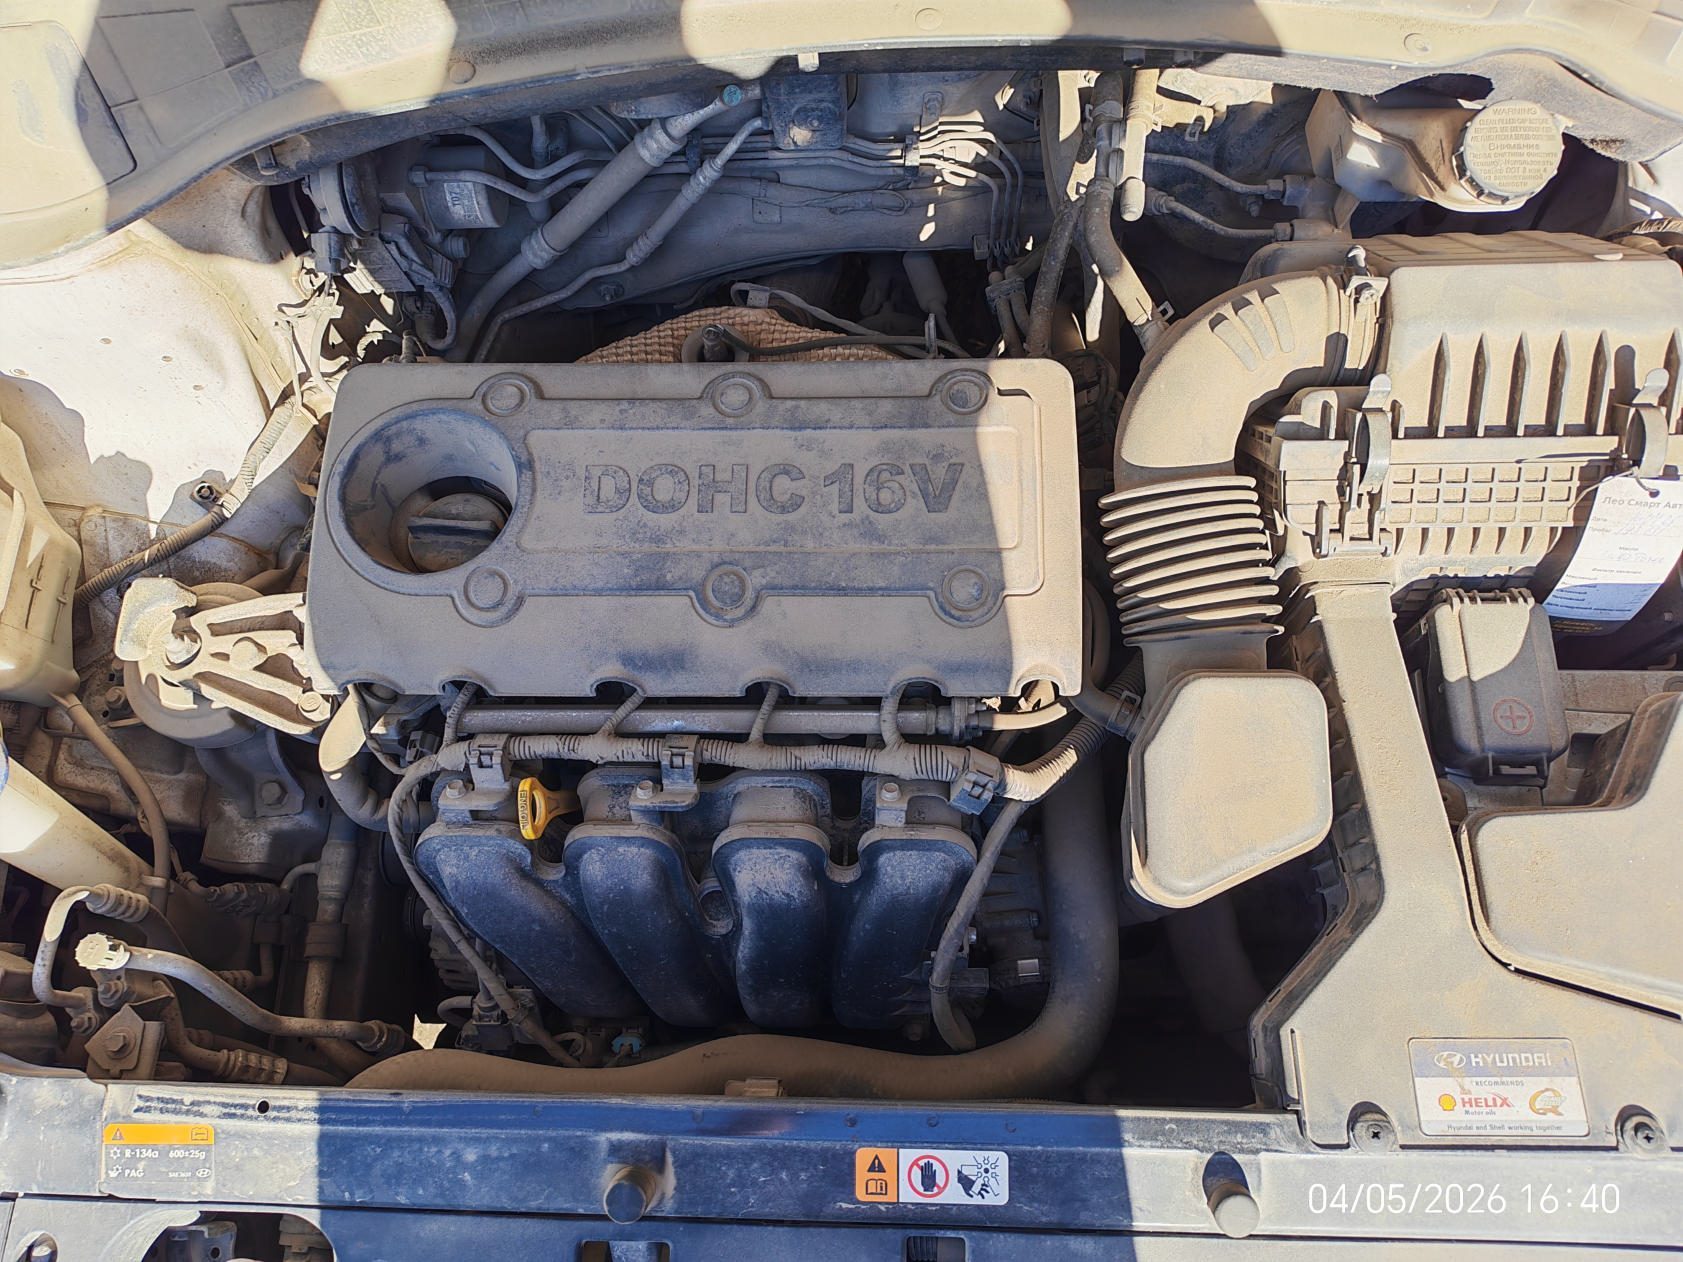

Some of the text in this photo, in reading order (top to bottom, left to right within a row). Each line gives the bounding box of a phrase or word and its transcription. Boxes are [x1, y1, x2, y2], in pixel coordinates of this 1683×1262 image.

[1492, 107, 1537, 115] WARNING
[1488, 142, 1541, 151] Внимание
[583, 462, 964, 515] DOHC 16V
[1602, 496, 1625, 506] Лео
[1627, 498, 1661, 509] Смарт
[1471, 1052, 1551, 1067] HYUNDAI
[1461, 1096, 1513, 1108] HELIX
[1447, 1124, 1473, 1132] Hyundai
[1507, 1124, 1533, 1132] working
[125, 1149, 206, 1160] R-134a 600±25g
[124, 1168, 145, 1178] PAG
